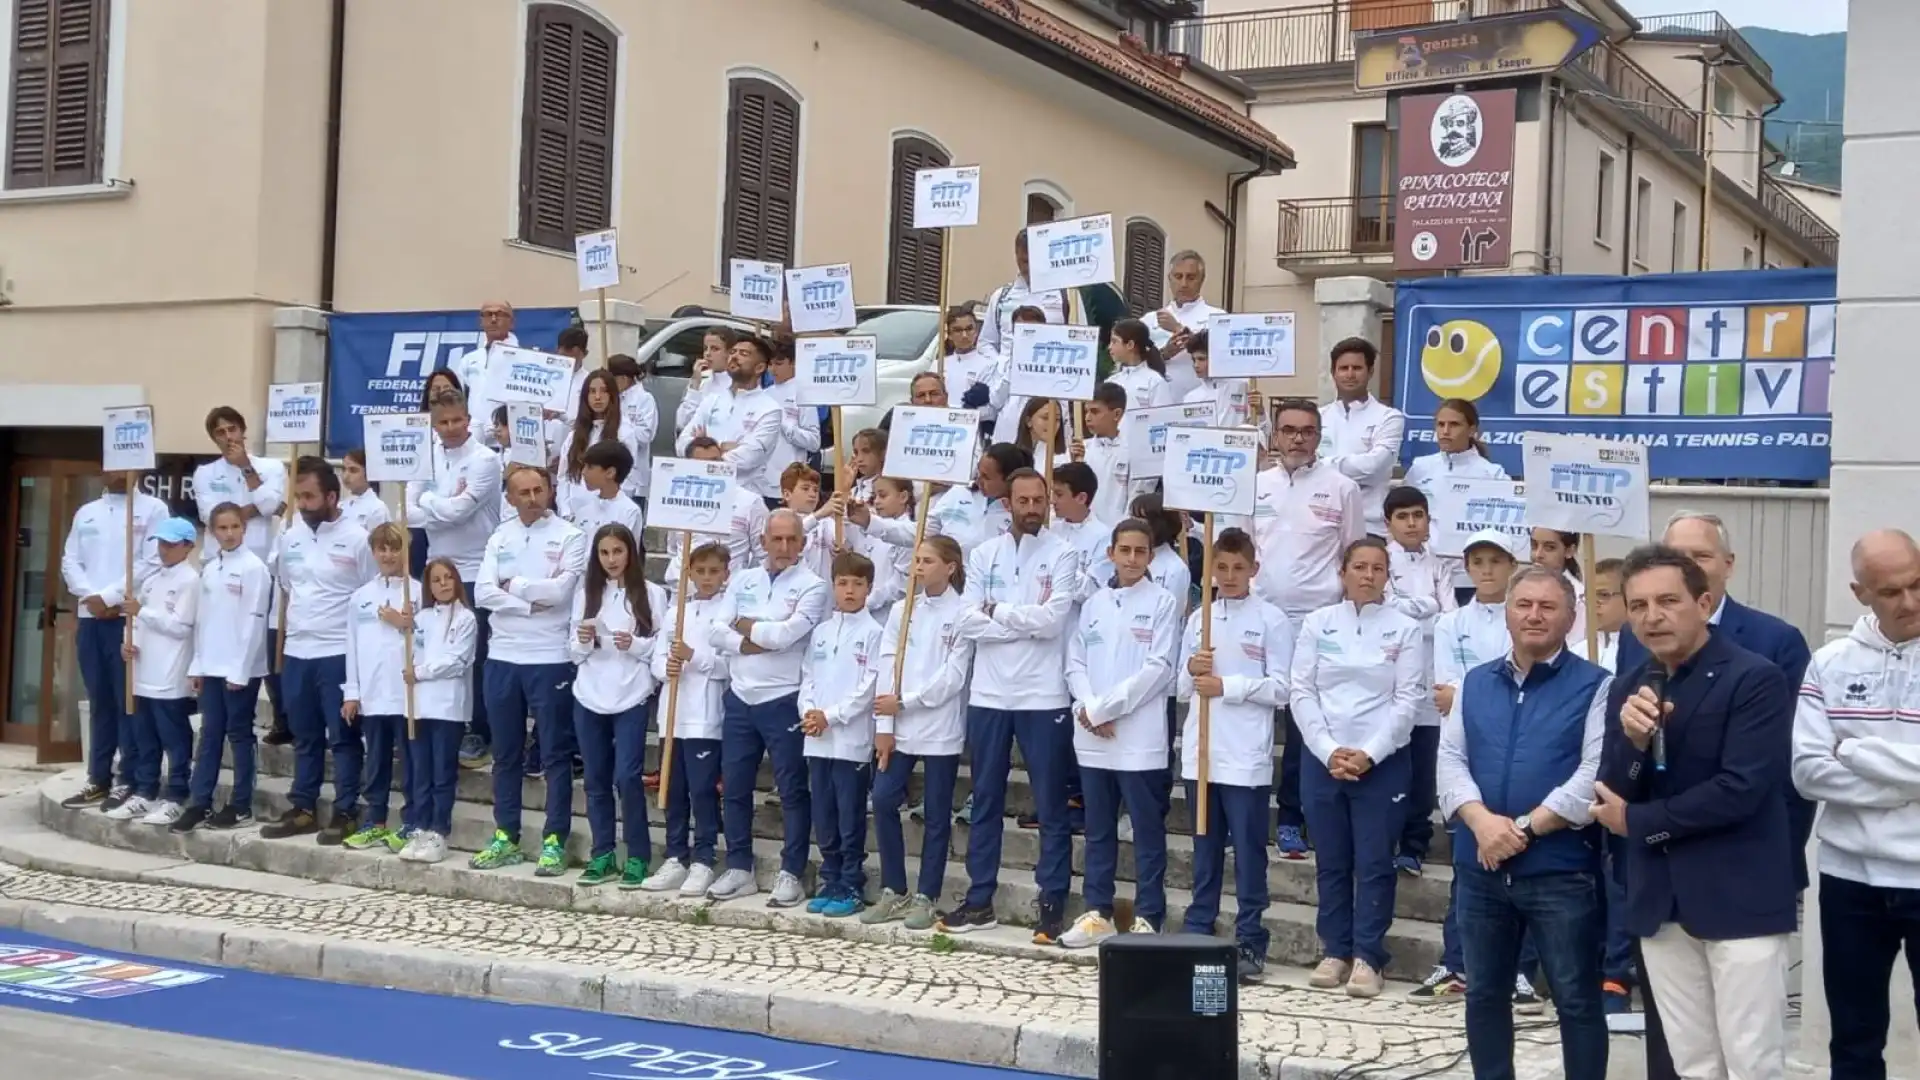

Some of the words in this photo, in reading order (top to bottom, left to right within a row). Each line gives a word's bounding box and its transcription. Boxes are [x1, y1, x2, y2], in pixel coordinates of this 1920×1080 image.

[930, 181, 972, 201] FITP
[1399, 171, 1510, 191] PINACOTECA
[1403, 191, 1504, 211] PATINIANA
[1048, 233, 1104, 260] FITP
[805, 301, 836, 311] VENETO
[1229, 328, 1286, 348] FITP
[1526, 309, 1836, 358] centr
[814, 353, 868, 374] FITP
[1031, 342, 1088, 365] FITP
[1017, 363, 1046, 373] VALLE
[812, 374, 858, 384] BOLZANO
[909, 424, 968, 448] FITP
[1673, 433, 1759, 447] TENNIS
[1761, 434, 1774, 445] e
[903, 446, 957, 458] PIEMONTE
[1186, 450, 1247, 475] FITP
[670, 476, 727, 499] FITP
[1192, 474, 1225, 487] LAZIO
[1551, 464, 1632, 494] FITP
[661, 496, 721, 510] LOMBARDIA
[1555, 491, 1613, 506] TRENTO
